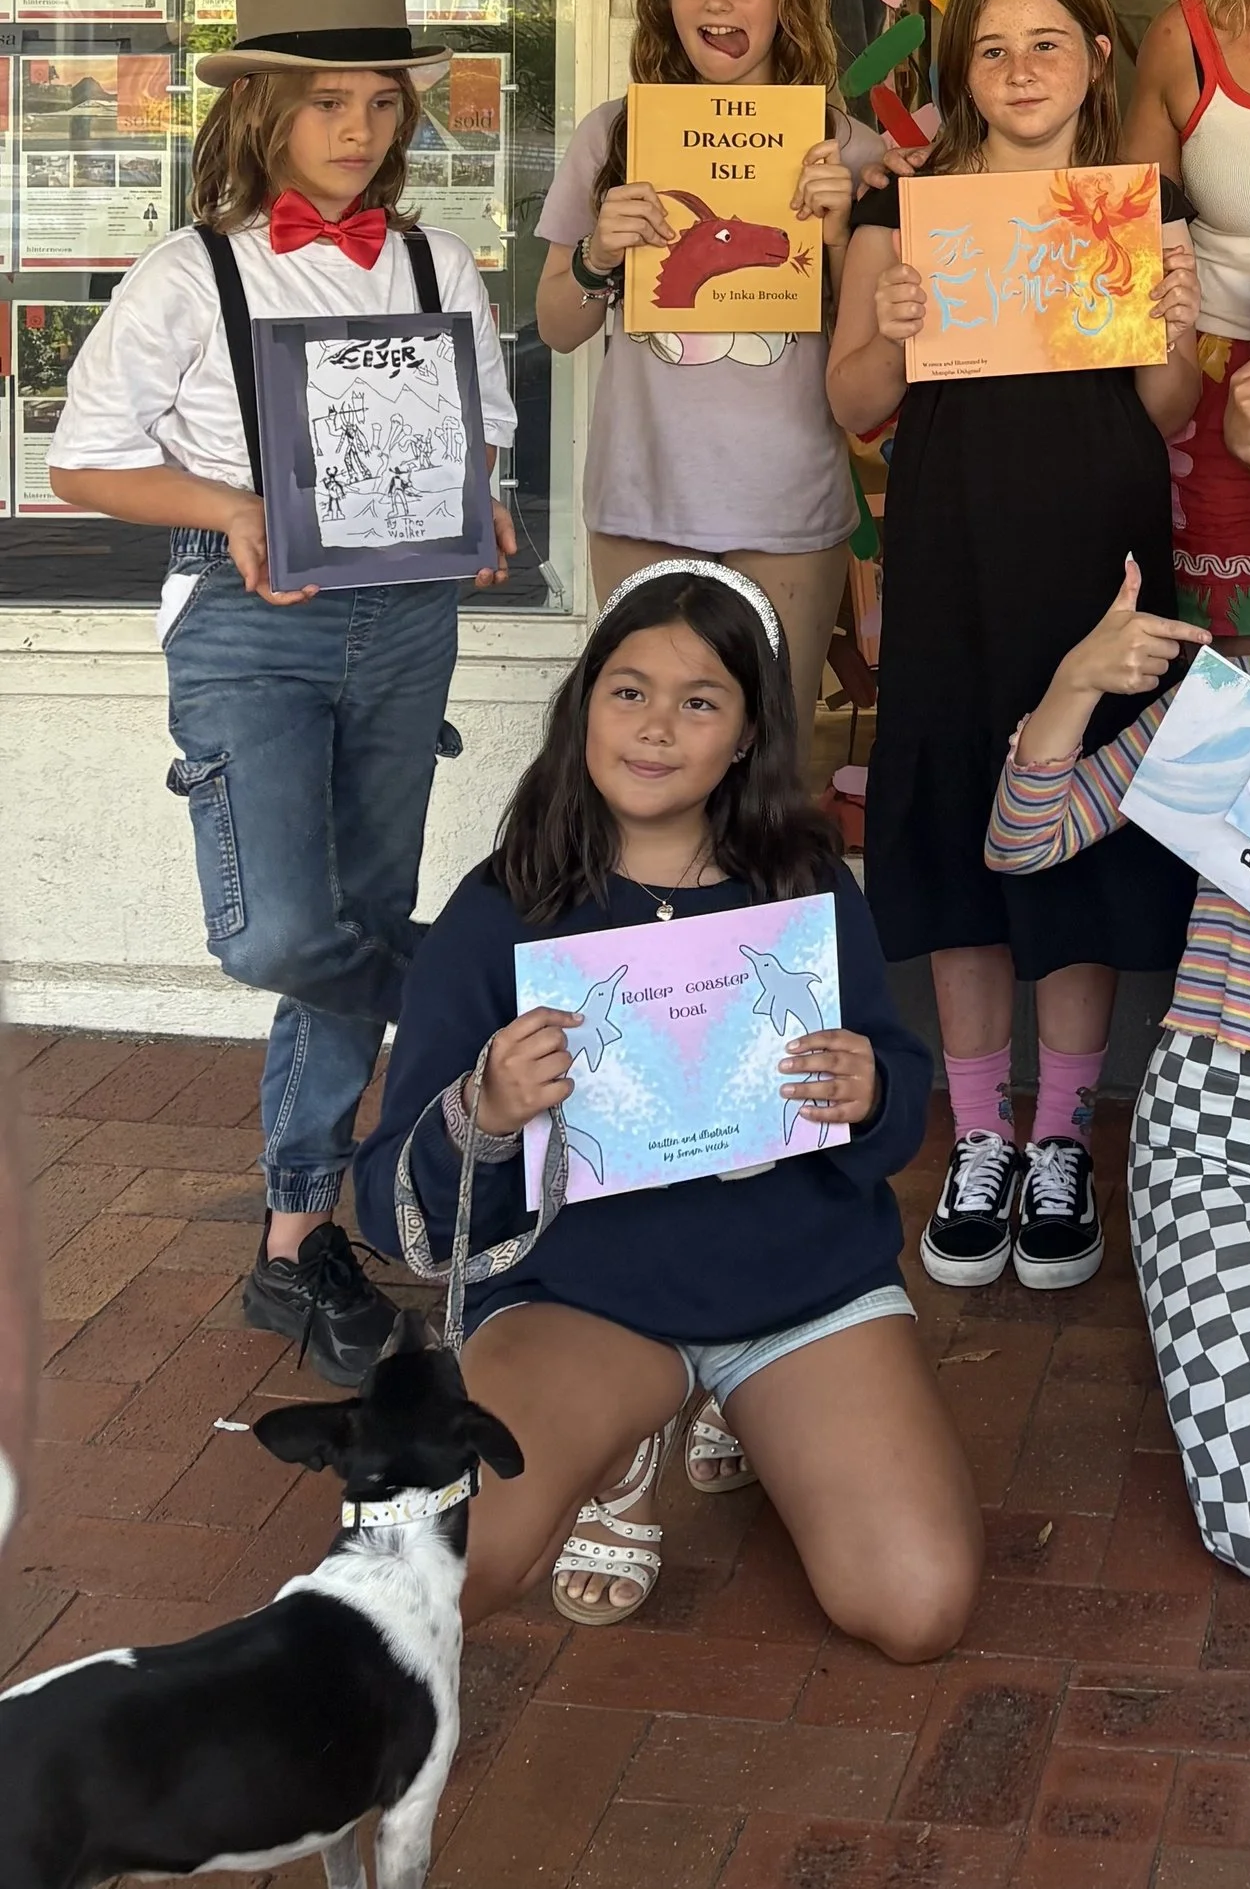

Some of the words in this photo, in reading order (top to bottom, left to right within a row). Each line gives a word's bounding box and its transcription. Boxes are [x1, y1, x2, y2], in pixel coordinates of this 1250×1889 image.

[454, 111, 492, 129] sold
[1003, 216, 1092, 274] Four
[712, 289, 726, 302] by
[729, 290, 755, 300] Inka
[758, 290, 798, 300] Brooke
[929, 267, 1115, 336] Elements
[622, 986, 673, 1005] Roller
[685, 972, 749, 994] coaster
[669, 1003, 707, 1020] boat
[681, 1132, 697, 1143] and
[663, 1152, 674, 1162] by
